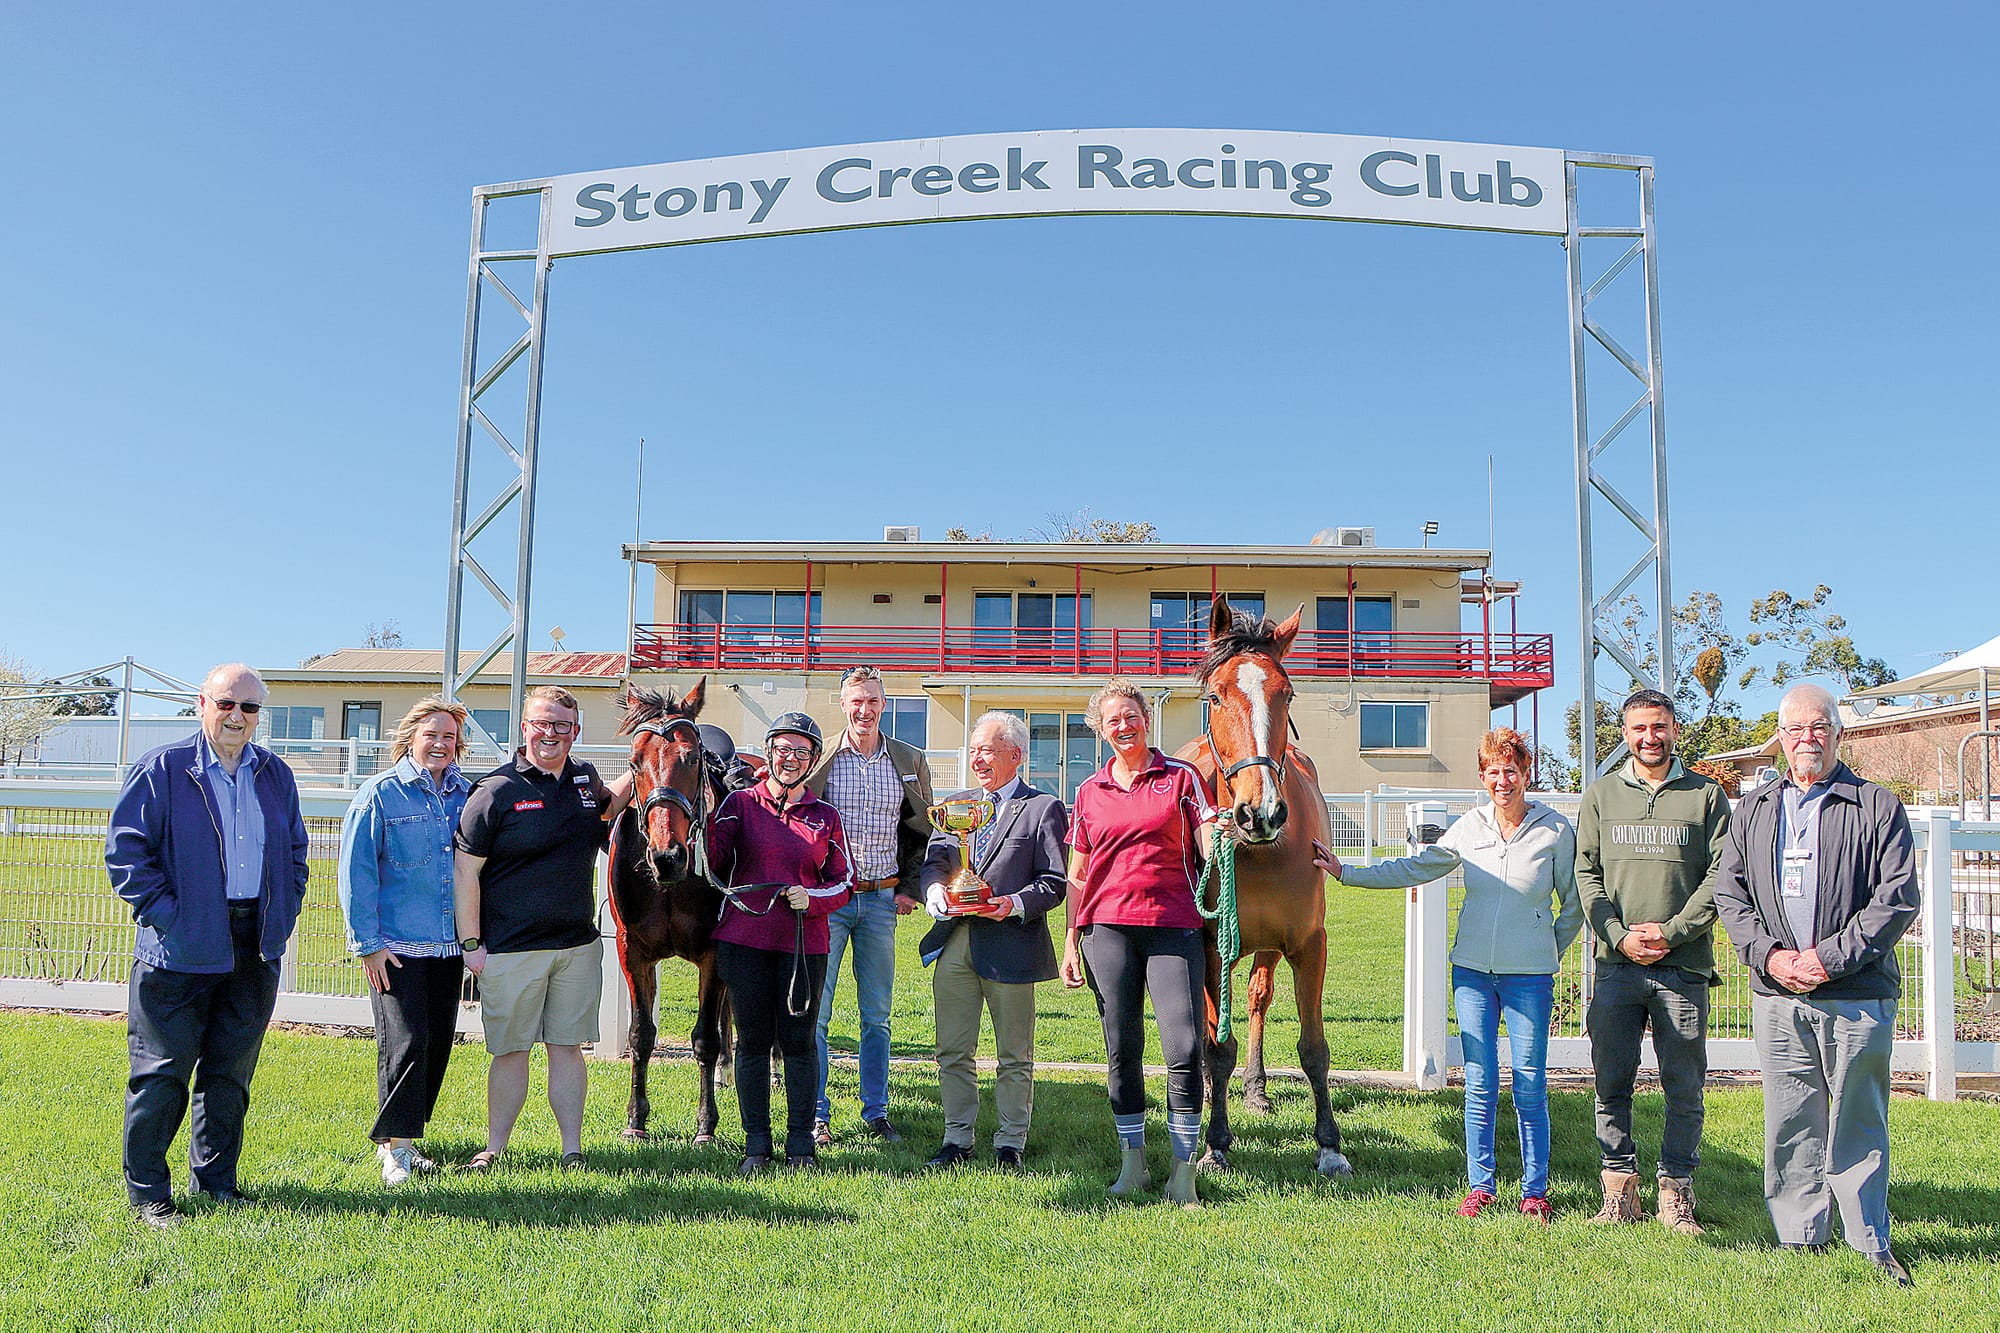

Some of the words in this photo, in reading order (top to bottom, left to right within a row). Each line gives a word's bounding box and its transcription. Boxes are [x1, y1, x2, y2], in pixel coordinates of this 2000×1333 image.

[574, 176, 792, 228] Stony
[815, 147, 1052, 203] Creek
[1077, 144, 1333, 208] Racing
[1359, 150, 1543, 208] Club
[1612, 824, 1659, 845] COUNTRY
[1660, 825, 1689, 846] ROAD
